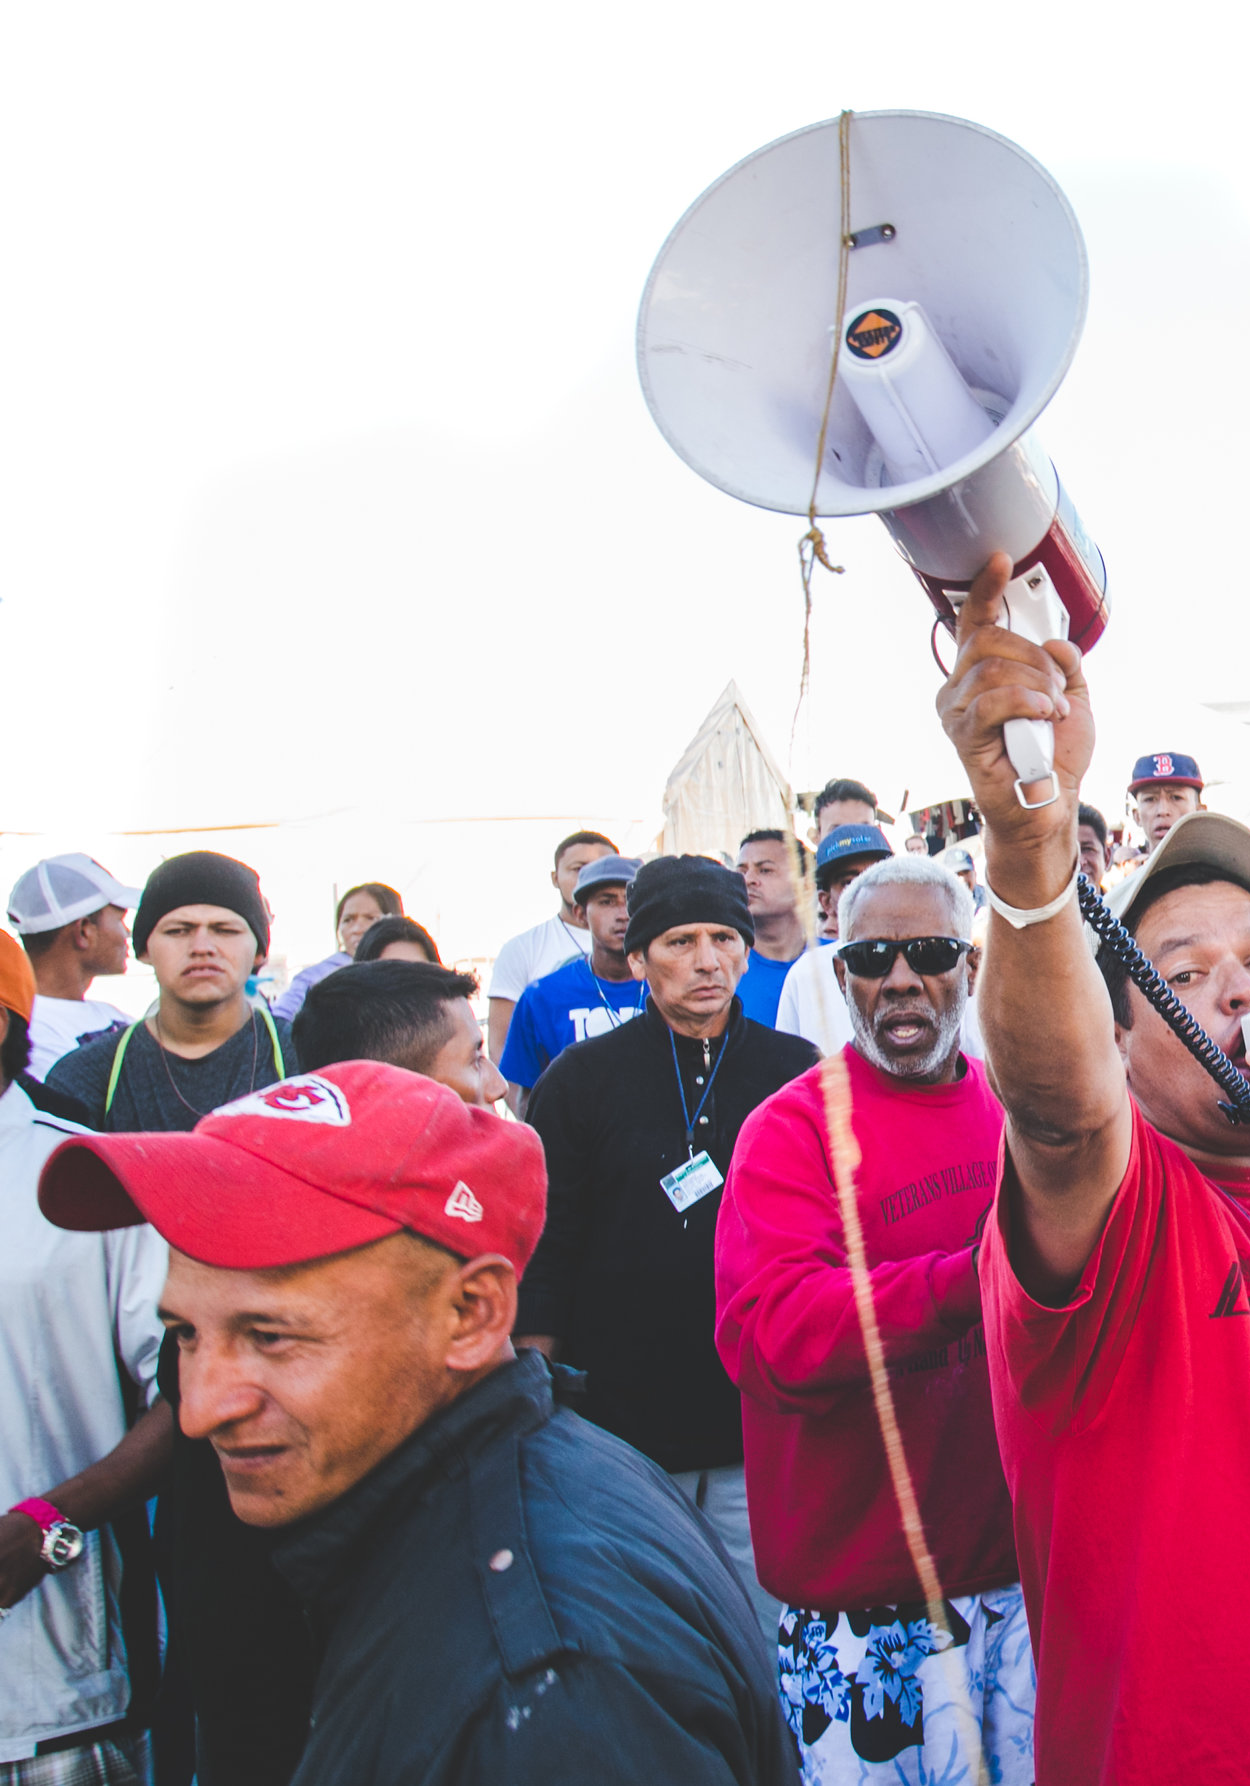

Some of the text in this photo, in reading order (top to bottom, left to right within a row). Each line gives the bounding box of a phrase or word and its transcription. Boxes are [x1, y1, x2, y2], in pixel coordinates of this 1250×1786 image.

[1153, 754, 1175, 777] B
[880, 1172, 942, 1227] VETERANS
[940, 1160, 989, 1196] VILLAGE
